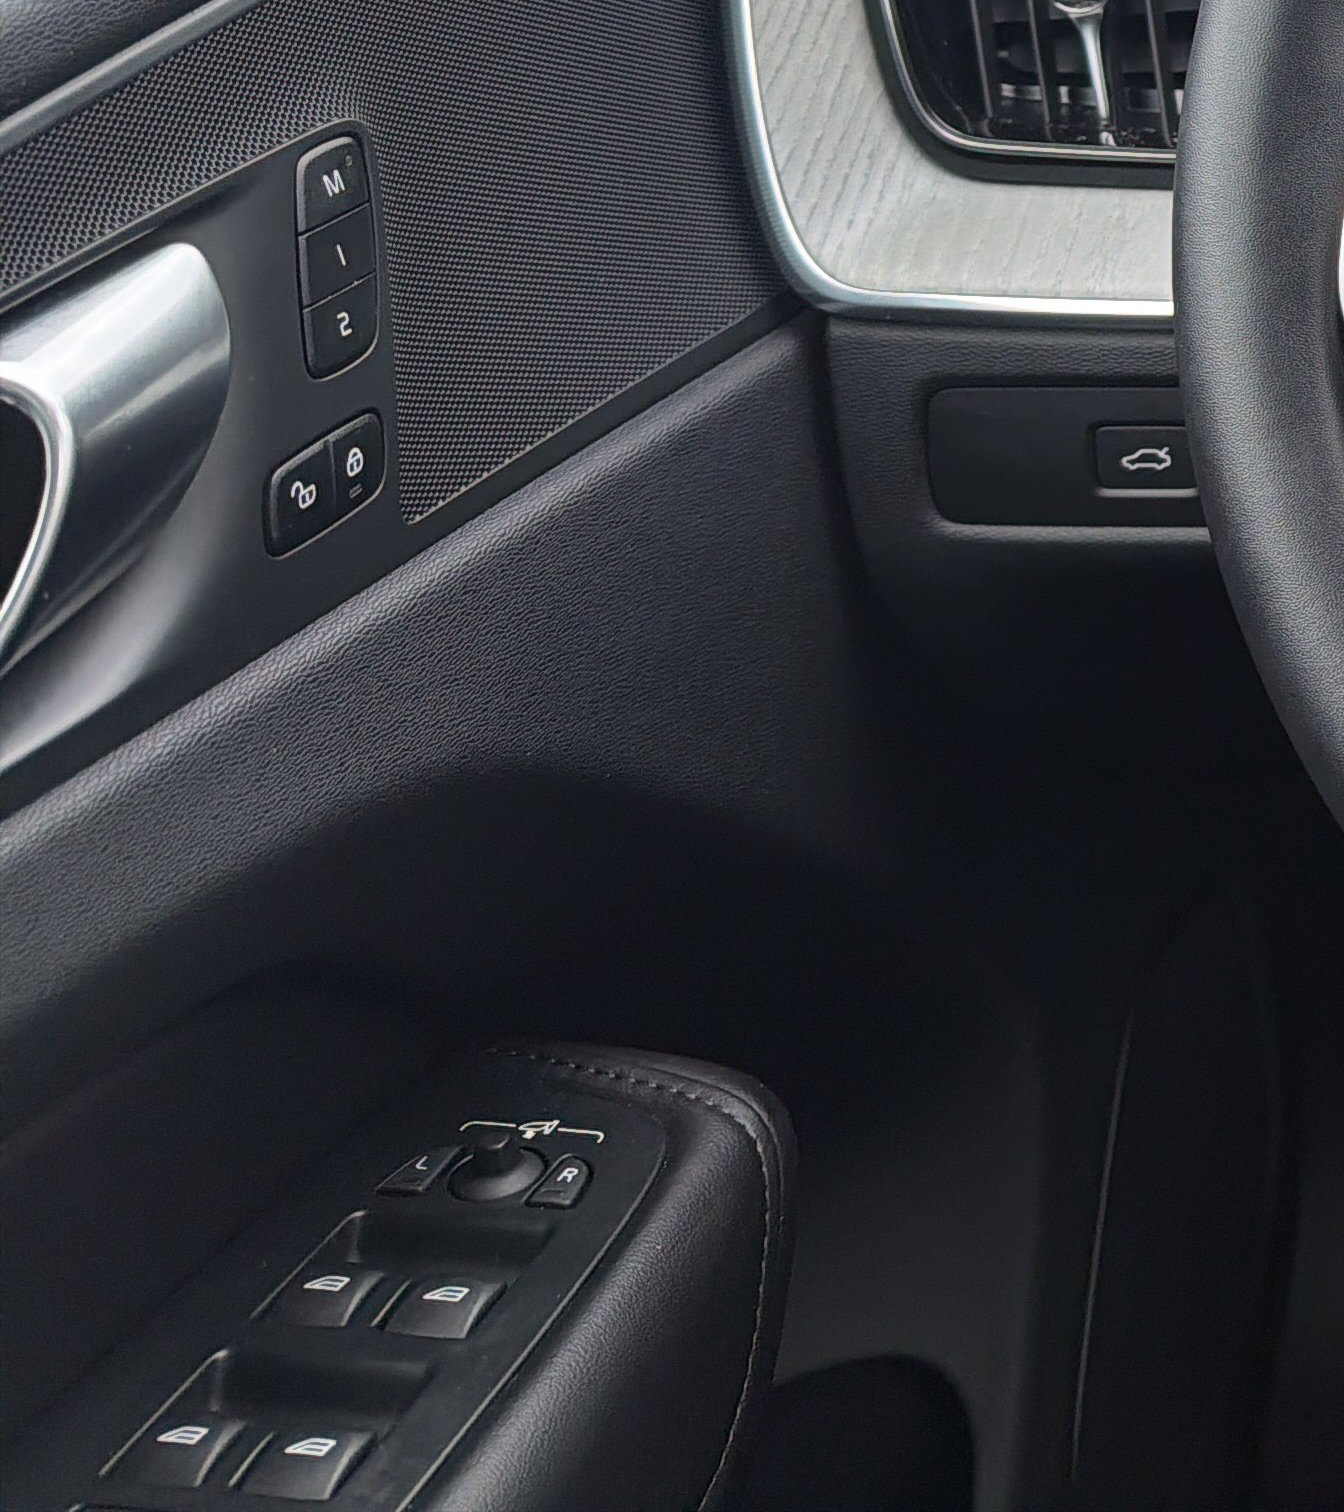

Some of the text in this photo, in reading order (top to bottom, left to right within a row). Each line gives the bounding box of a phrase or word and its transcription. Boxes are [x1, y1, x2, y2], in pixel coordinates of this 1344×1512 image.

[323, 169, 346, 198] M
[336, 312, 353, 338] 2
[415, 1155, 429, 1170] L
[556, 1167, 579, 1183] R
